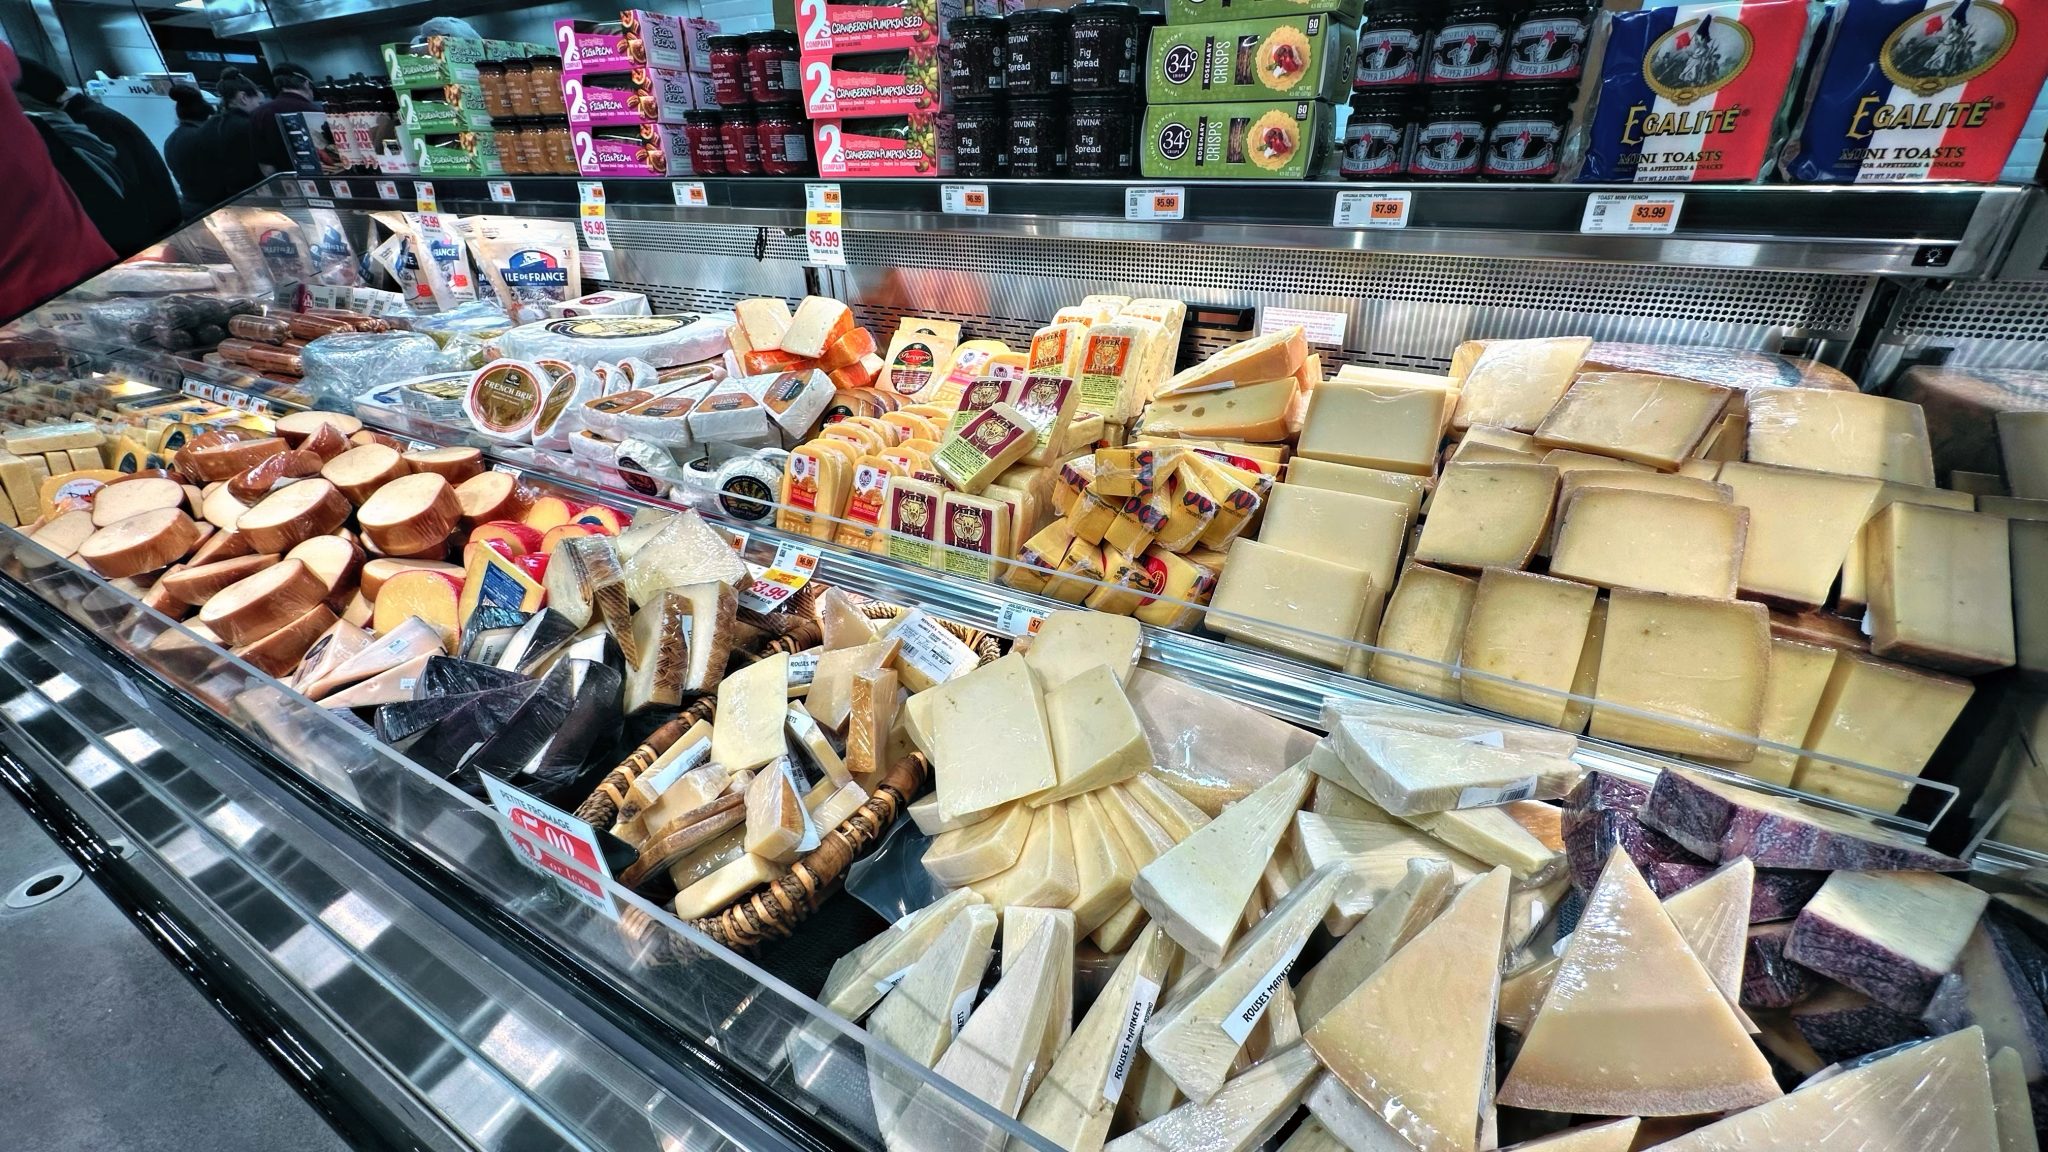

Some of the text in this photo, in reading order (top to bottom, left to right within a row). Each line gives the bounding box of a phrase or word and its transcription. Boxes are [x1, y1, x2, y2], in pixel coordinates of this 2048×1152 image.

[1309, 18, 1319, 29] 60
[1008, 35, 1028, 44] DIVINA
[1075, 30, 1099, 39] DIVINA
[806, 39, 831, 48] COMPANY
[1012, 53, 1022, 63] Fig
[1079, 48, 1091, 59] Fig
[953, 59, 962, 68] Fig
[1008, 61, 1031, 72] Spread
[1073, 58, 1099, 68] Spread
[1203, 43, 1212, 84] ROSEMARY
[1213, 41, 1231, 84] CRISPS
[950, 68, 969, 76] Spread
[1297, 105, 1307, 114] 60
[1845, 91, 1993, 140] ÉGALITÉ
[1076, 118, 1101, 127] DIVINA
[1621, 100, 1741, 146] ÉGALITÉ
[962, 136, 973, 146] Fig
[1019, 136, 1030, 146] Fig
[1081, 135, 1094, 145] Fig
[1197, 122, 1205, 161] ROSEMARY
[1206, 121, 1223, 161] CRISPS
[957, 145, 980, 154] Spread
[1013, 145, 1038, 154] Spread
[1075, 145, 1101, 154] Spread
[1840, 147, 1966, 160] MINI TOASTS
[1618, 151, 1722, 165] MINI TOASTS
[1157, 198, 1175, 207] $5.99
[1375, 204, 1398, 214] $7.99
[1637, 207, 1666, 218] $3.99
[421, 214, 440, 228] $5.99
[584, 221, 605, 235] $5.99
[809, 230, 839, 248] $5.99
[504, 272, 519, 281] ILE
[529, 272, 565, 281] FRANCE
[484, 380, 534, 400] FRENCH BRIE
[799, 557, 813, 567] $6.99
[752, 580, 789, 600] $3.99
[500, 790, 572, 832] PETITE FROMAGE
[550, 863, 591, 890] or less
[1242, 959, 1296, 1023] ROUSES MARKETS
[1114, 1001, 1142, 1080] ROUSES MARKETS
